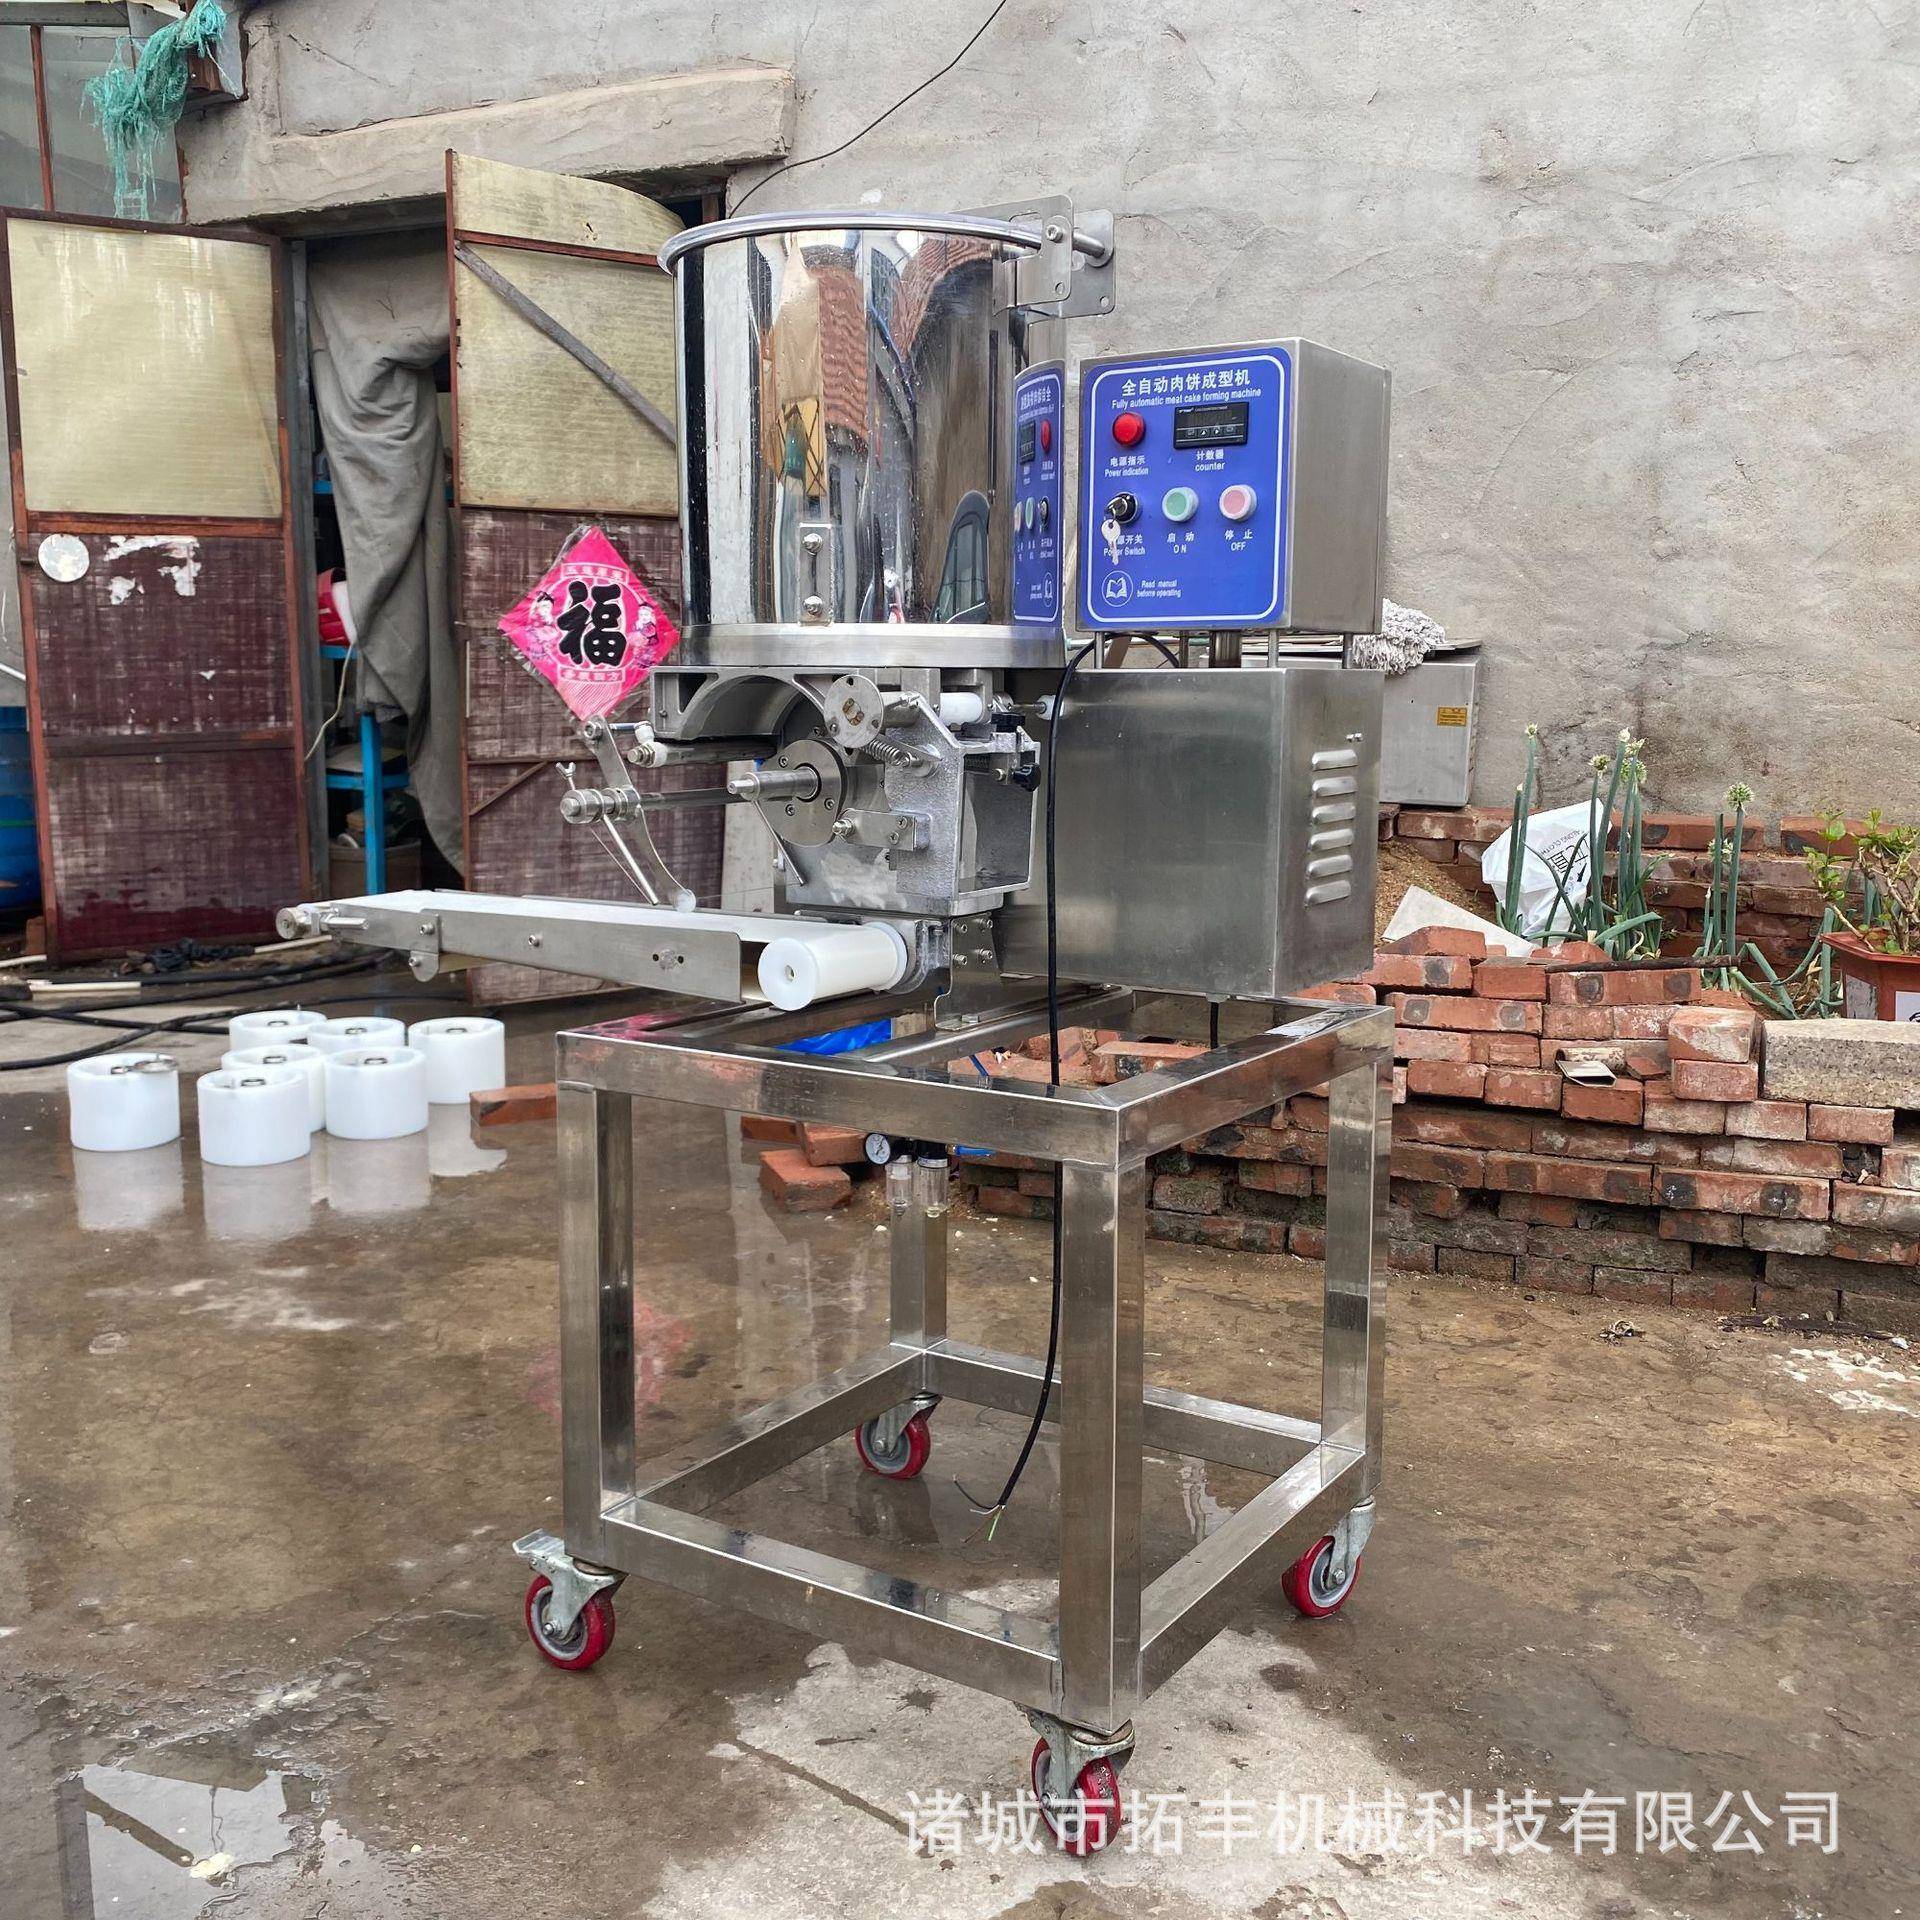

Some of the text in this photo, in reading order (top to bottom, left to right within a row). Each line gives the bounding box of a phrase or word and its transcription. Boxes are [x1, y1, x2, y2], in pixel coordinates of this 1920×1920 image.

[1121, 369, 1250, 397] 全自动肉饼成型机
[1112, 399, 1128, 410] Fully
[1130, 396, 1164, 408] automatic
[1184, 392, 1201, 403] cake
[1202, 390, 1230, 402] forming
[1231, 387, 1262, 399] machine
[1110, 455, 1146, 467] 电源指示
[1196, 449, 1224, 461] 计数器
[1104, 466, 1149, 477] Power indication
[1195, 461, 1226, 472] counter
[1167, 531, 1195, 543] 启动
[1224, 529, 1253, 541] 停止
[1103, 546, 1146, 557] Poer Switch
[1230, 541, 1247, 552] OFF
[557, 580, 627, 667] 福
